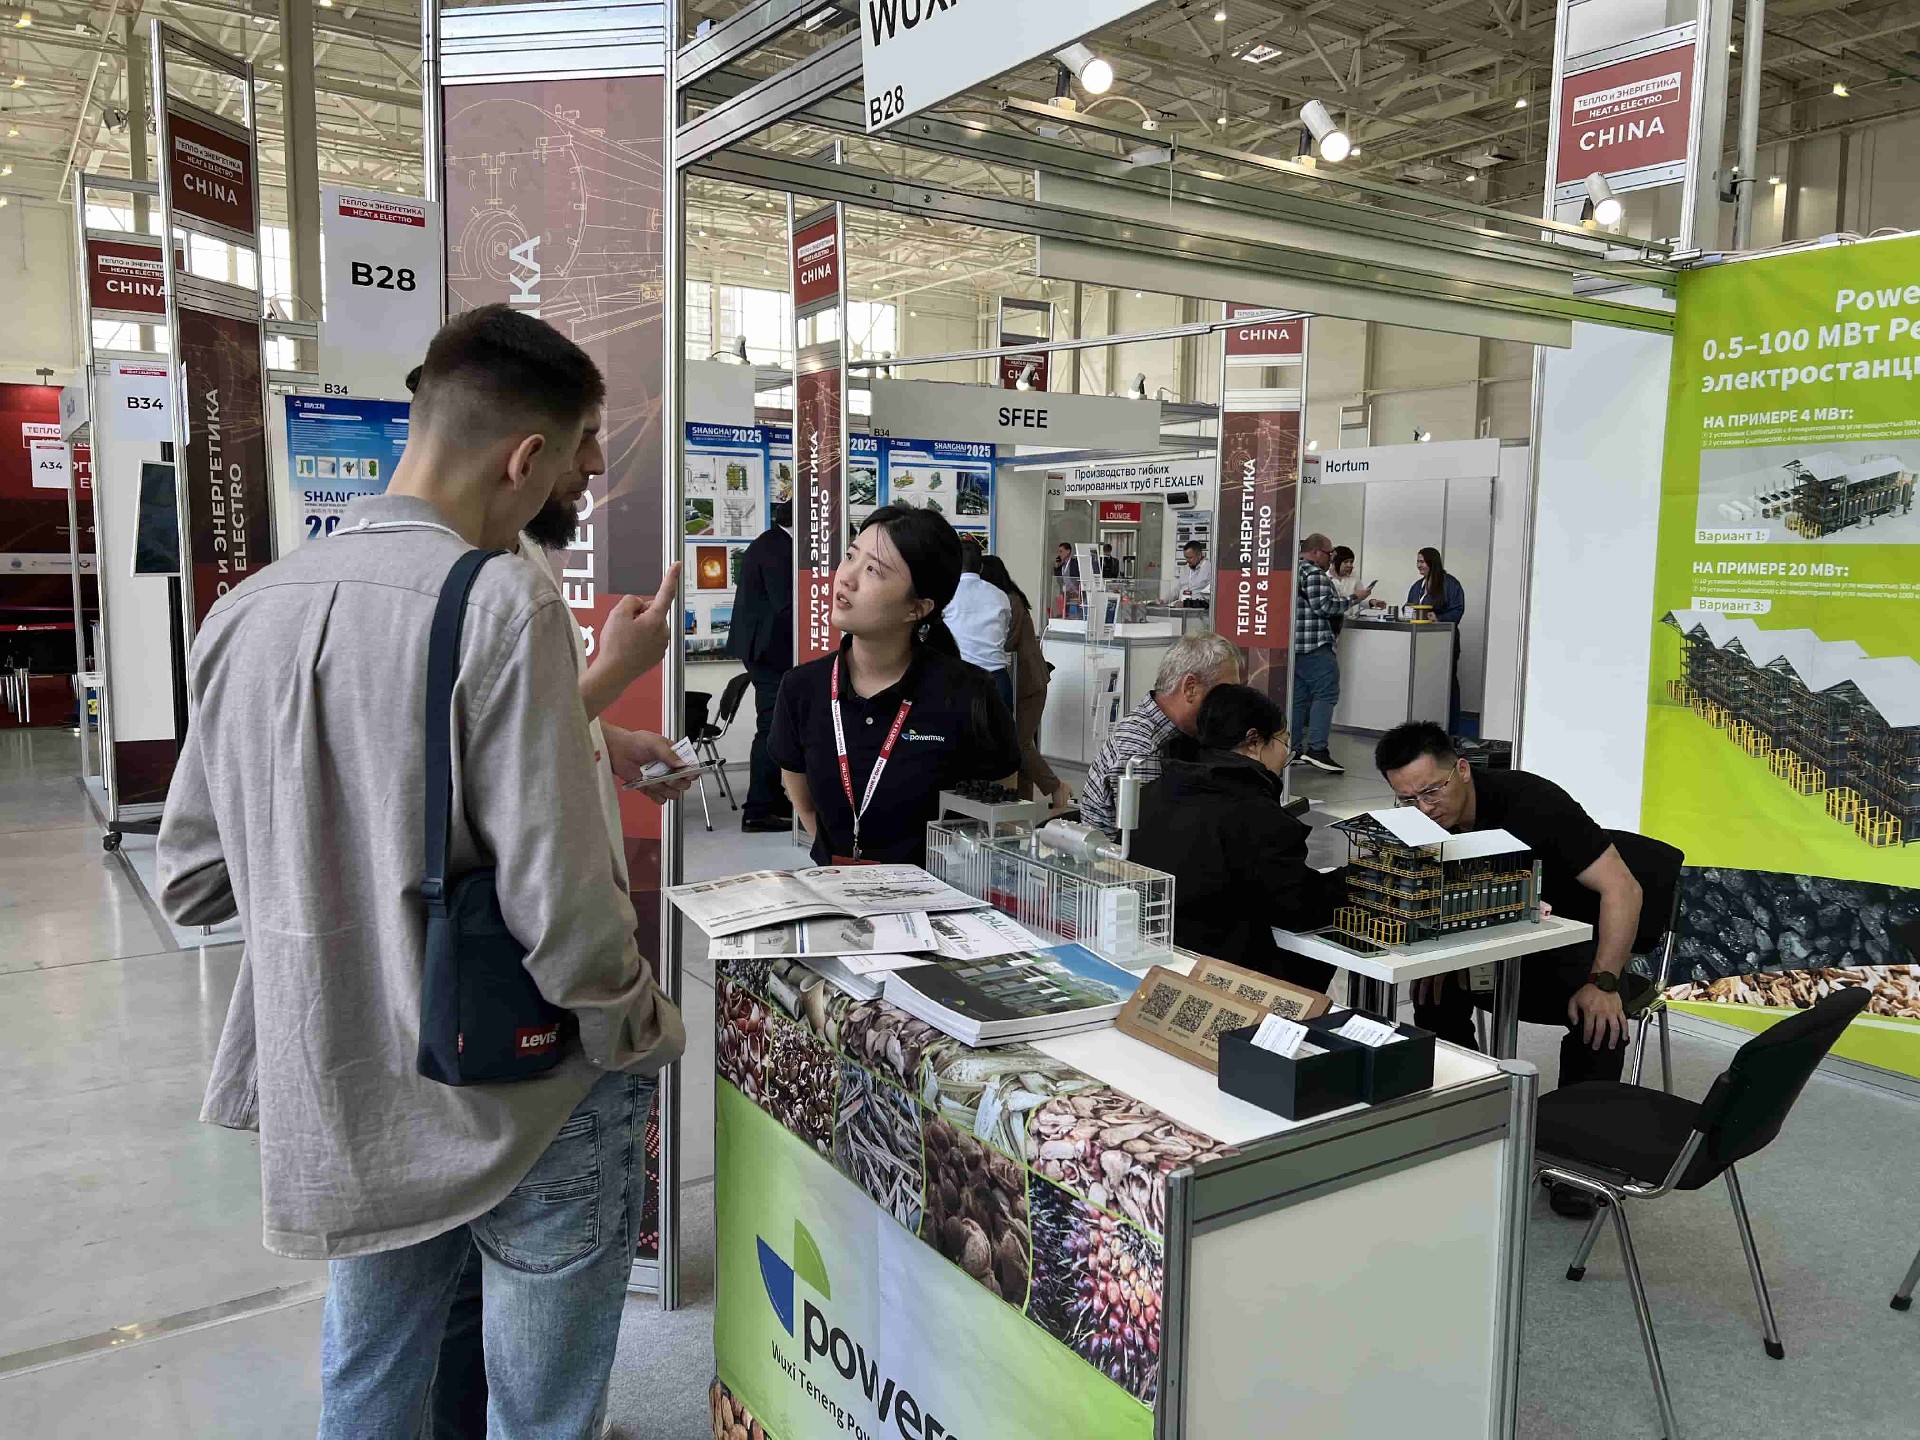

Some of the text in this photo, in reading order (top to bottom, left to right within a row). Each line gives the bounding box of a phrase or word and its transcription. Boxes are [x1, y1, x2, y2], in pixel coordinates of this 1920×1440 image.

[1578, 94, 1607, 107] ТЕПЛО
[1617, 77, 1677, 98] ЭНЕРГЕТИКА
[870, 85, 904, 126] B28
[1589, 105, 1613, 118] HEAT
[1620, 94, 1662, 111] ELECTRO
[1580, 116, 1664, 151] CHINA
[183, 173, 238, 206] CHINA
[342, 198, 367, 207] ТЕПЛО
[375, 203, 422, 215] ЭНЕРГЕТИКА
[353, 209, 372, 217] HEAT
[380, 213, 412, 223] ELECTRO
[352, 261, 416, 292] B28
[801, 262, 832, 285] CHINA
[1239, 329, 1289, 341] CHINA
[1818, 322, 1881, 349] МВт
[324, 383, 348, 395] B34
[127, 396, 164, 410] B34
[998, 407, 1048, 429] SFEE
[1703, 407, 1854, 429] НА ПРИМЕРЕ 4 МВт:
[692, 426, 732, 436] SHANGHAI
[731, 428, 762, 443] 2025
[874, 428, 890, 437] B34
[850, 438, 878, 452] 2025
[934, 442, 967, 451] SHANGHAI
[967, 444, 991, 458] 2025
[40, 461, 63, 470] A34
[206, 389, 228, 552] ЭНЕРГЕТИКА
[1075, 464, 1169, 480] Производство гибких
[1325, 459, 1369, 473] Hortum
[1130, 478, 1151, 492] труб
[1153, 475, 1204, 488] FLEXALEN
[1302, 476, 1316, 484] B34
[810, 431, 819, 562] ЭНЕРГЕТИКА
[229, 463, 247, 571] ELECTRO
[1105, 512, 1131, 520] LOUNGE
[1240, 458, 1256, 563] ЭНЕРГЕТИКА
[1698, 530, 1765, 543] Вариант 1:
[821, 489, 829, 651] HEAT & ELECTRO
[1255, 505, 1272, 636] HEAT & ELECTRO
[1693, 561, 1850, 578] НА ПРИМЕРЕ 20 МВт:
[1237, 583, 1251, 636] ТЕПЛО
[1699, 599, 1764, 612] Вариант 3:
[811, 583, 819, 651] ТЕПЛО
[909, 732, 945, 742] powermax
[771, 1339, 796, 1382] Wuxi
[798, 1368, 845, 1430] Teneng
